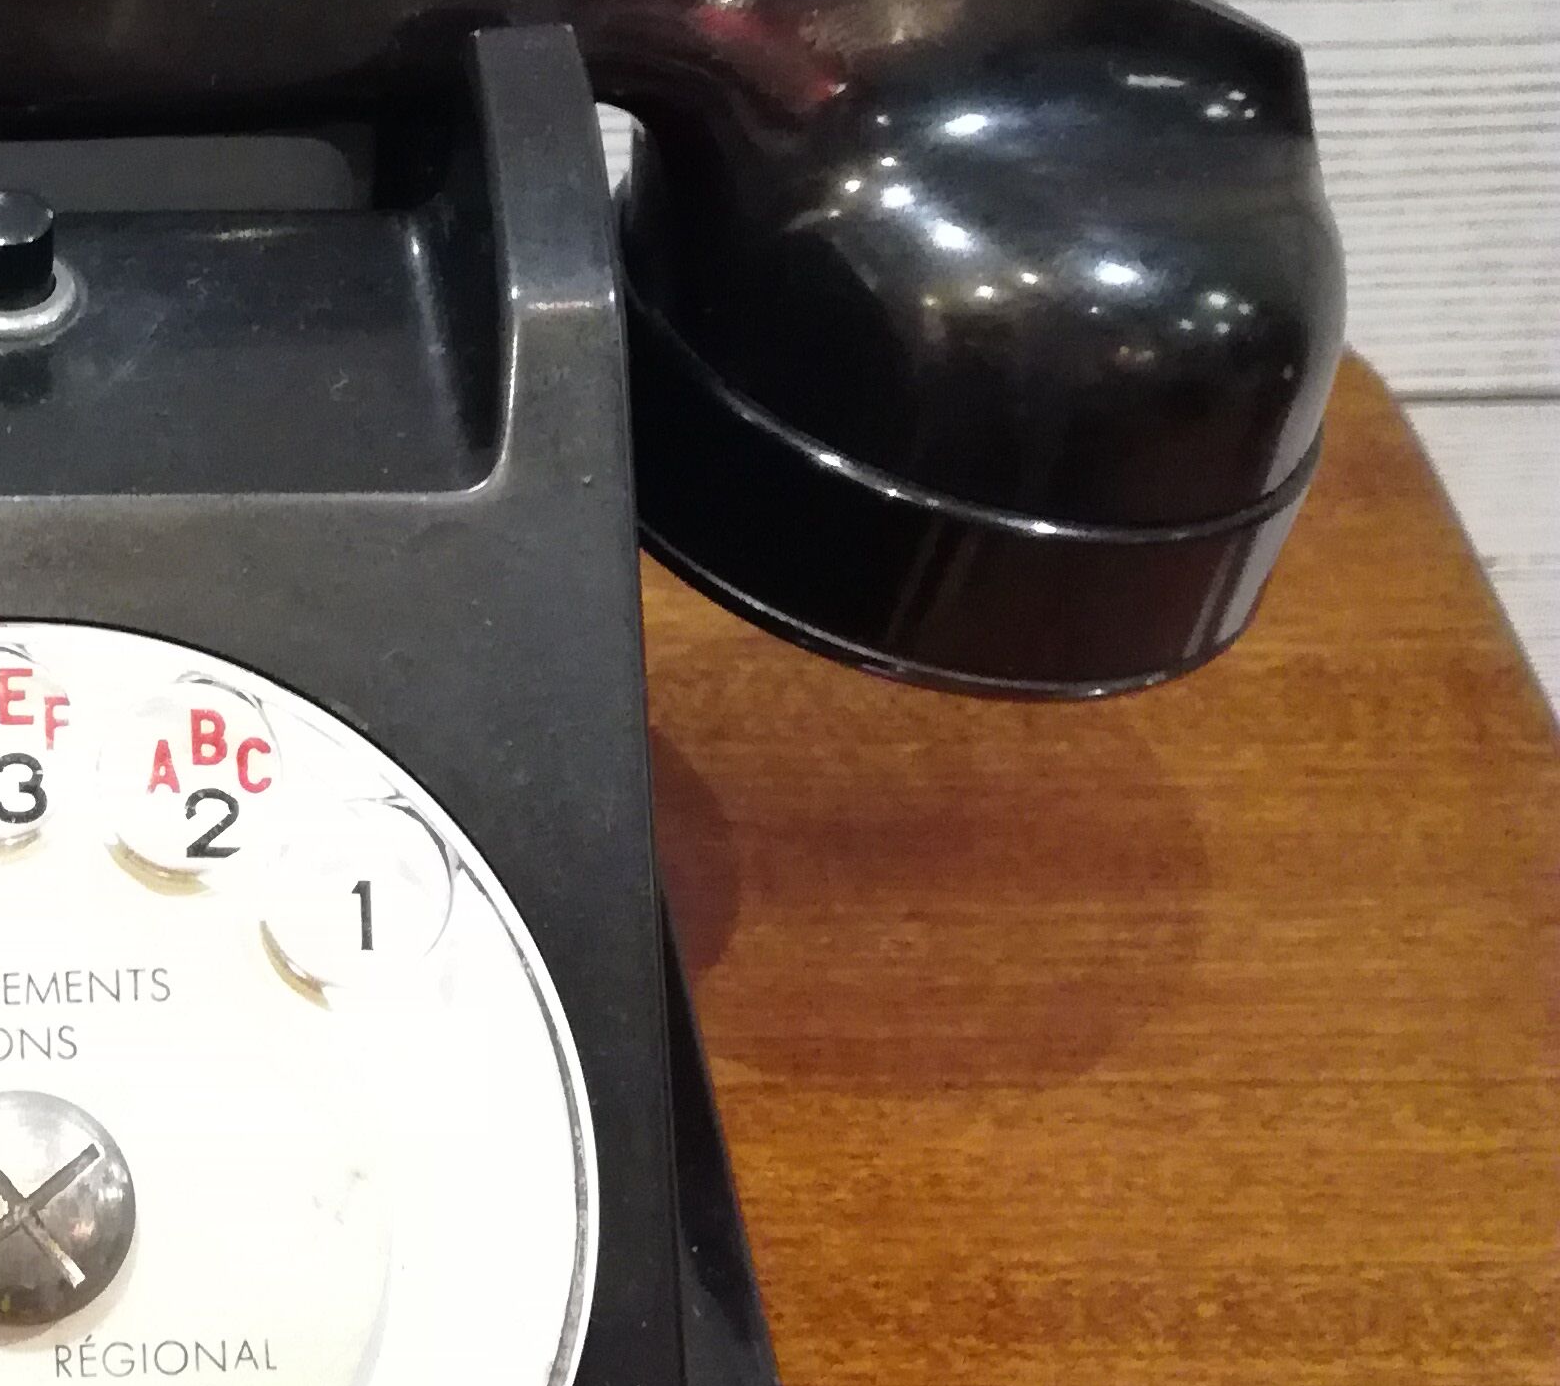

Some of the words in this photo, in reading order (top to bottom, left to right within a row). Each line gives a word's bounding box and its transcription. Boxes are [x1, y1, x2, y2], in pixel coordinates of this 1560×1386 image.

[146, 708, 272, 794] ABC
[184, 787, 241, 859] 2
[351, 879, 375, 952] 1
[54, 1333, 278, 1379] RÉGIONAL
